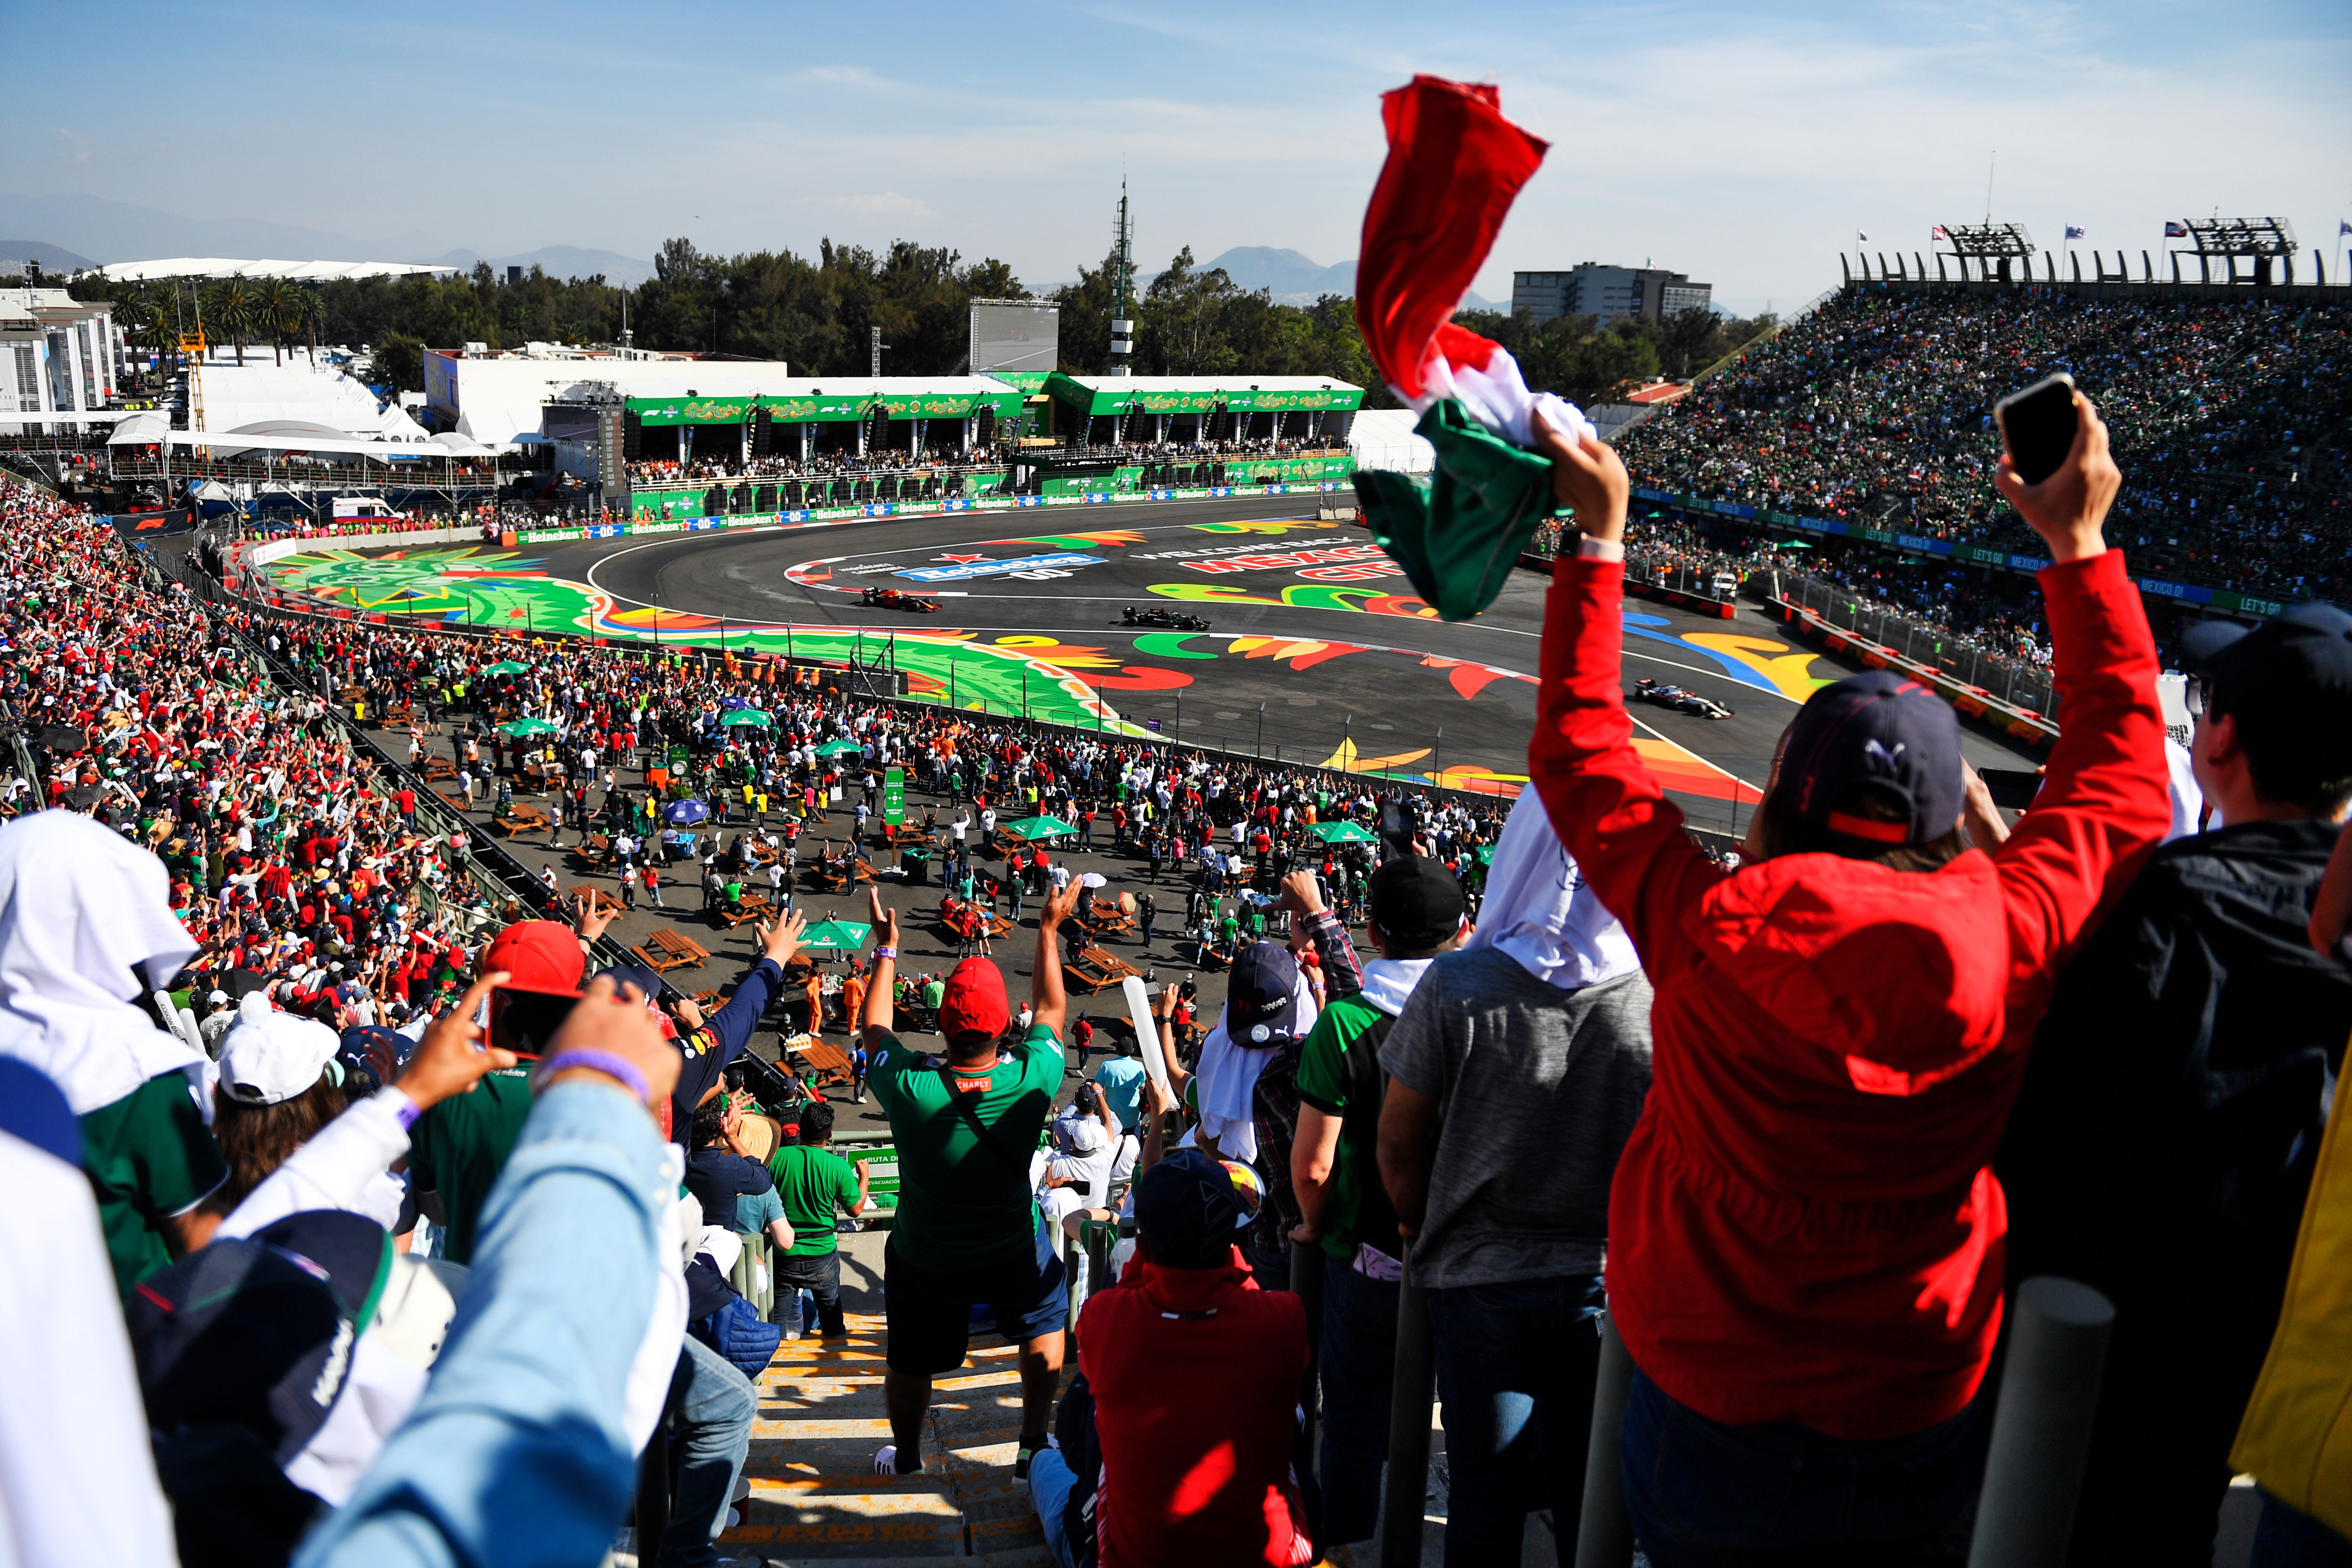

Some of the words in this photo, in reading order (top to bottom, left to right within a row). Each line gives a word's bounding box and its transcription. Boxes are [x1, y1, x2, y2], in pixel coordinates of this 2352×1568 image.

[1113, 491, 1144, 501] Heineken
[1176, 489, 1205, 498] Heineken
[1235, 487, 1262, 495] Heineken
[976, 498, 1010, 508] Heineken
[1047, 495, 1080, 505] Heineken
[817, 507, 857, 520] Heineken
[899, 501, 936, 513] Heineken
[727, 514, 772, 527] Heineken
[632, 522, 679, 534] Heineken
[528, 530, 579, 543] Heineken
[1866, 529, 1882, 540] LET'S
[1884, 533, 1892, 543] GO
[1130, 543, 1282, 560] WELCOME
[1277, 536, 1365, 549] BACK
[1974, 549, 1992, 562] LET'S
[1993, 553, 2003, 564] GO
[910, 556, 1092, 579] Heineken
[1295, 561, 1407, 581] CIT
[2240, 597, 2266, 613] LET'S
